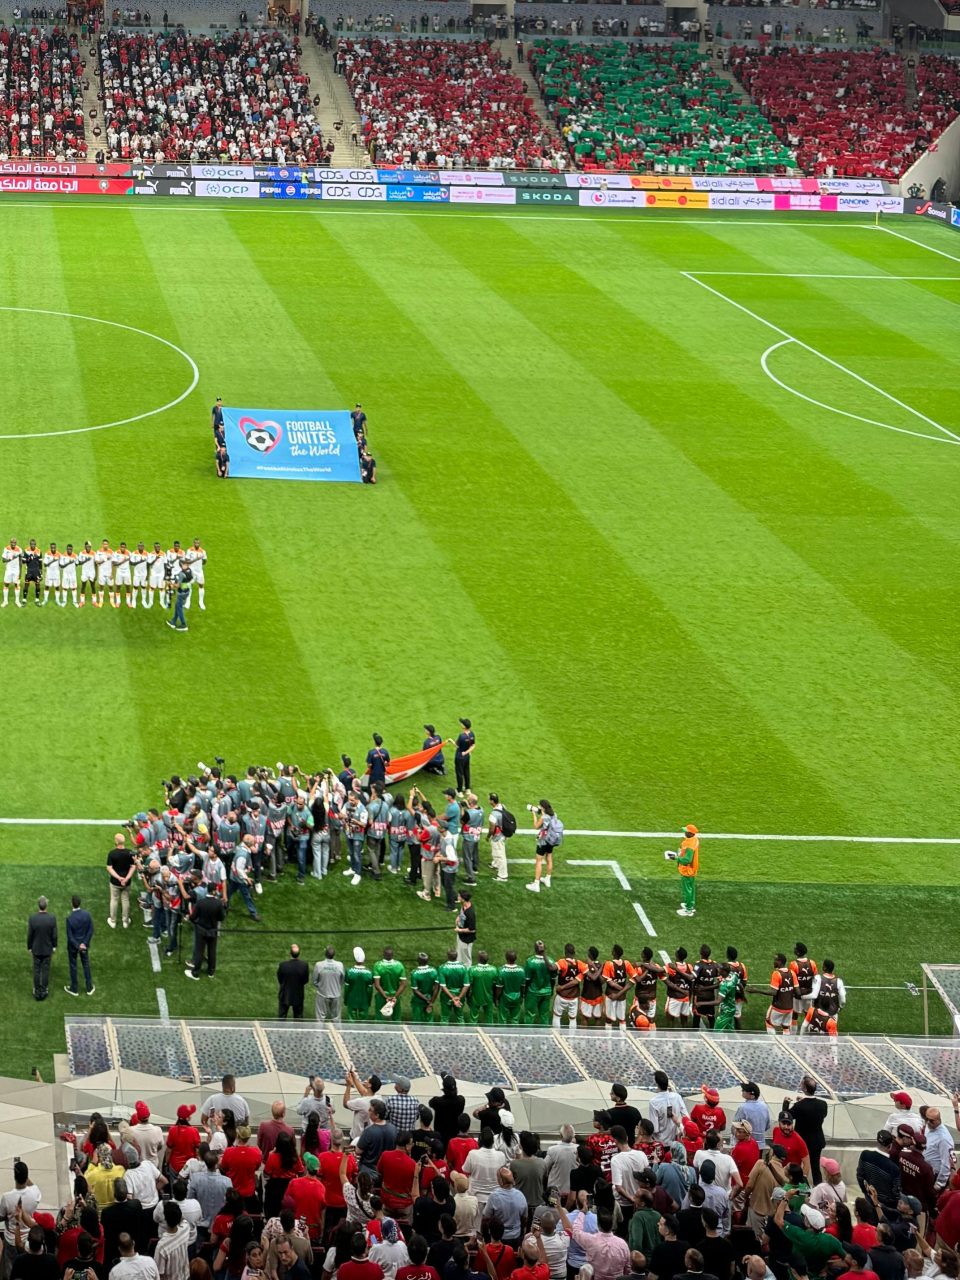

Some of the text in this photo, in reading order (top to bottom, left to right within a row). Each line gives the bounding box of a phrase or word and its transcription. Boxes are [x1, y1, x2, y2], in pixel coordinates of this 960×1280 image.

[327, 186, 352, 197] CDG
[358, 187, 383, 198] CDG
[286, 420, 332, 431] FOOTBALL
[287, 431, 337, 444] UNITES
[290, 444, 340, 456] the World
